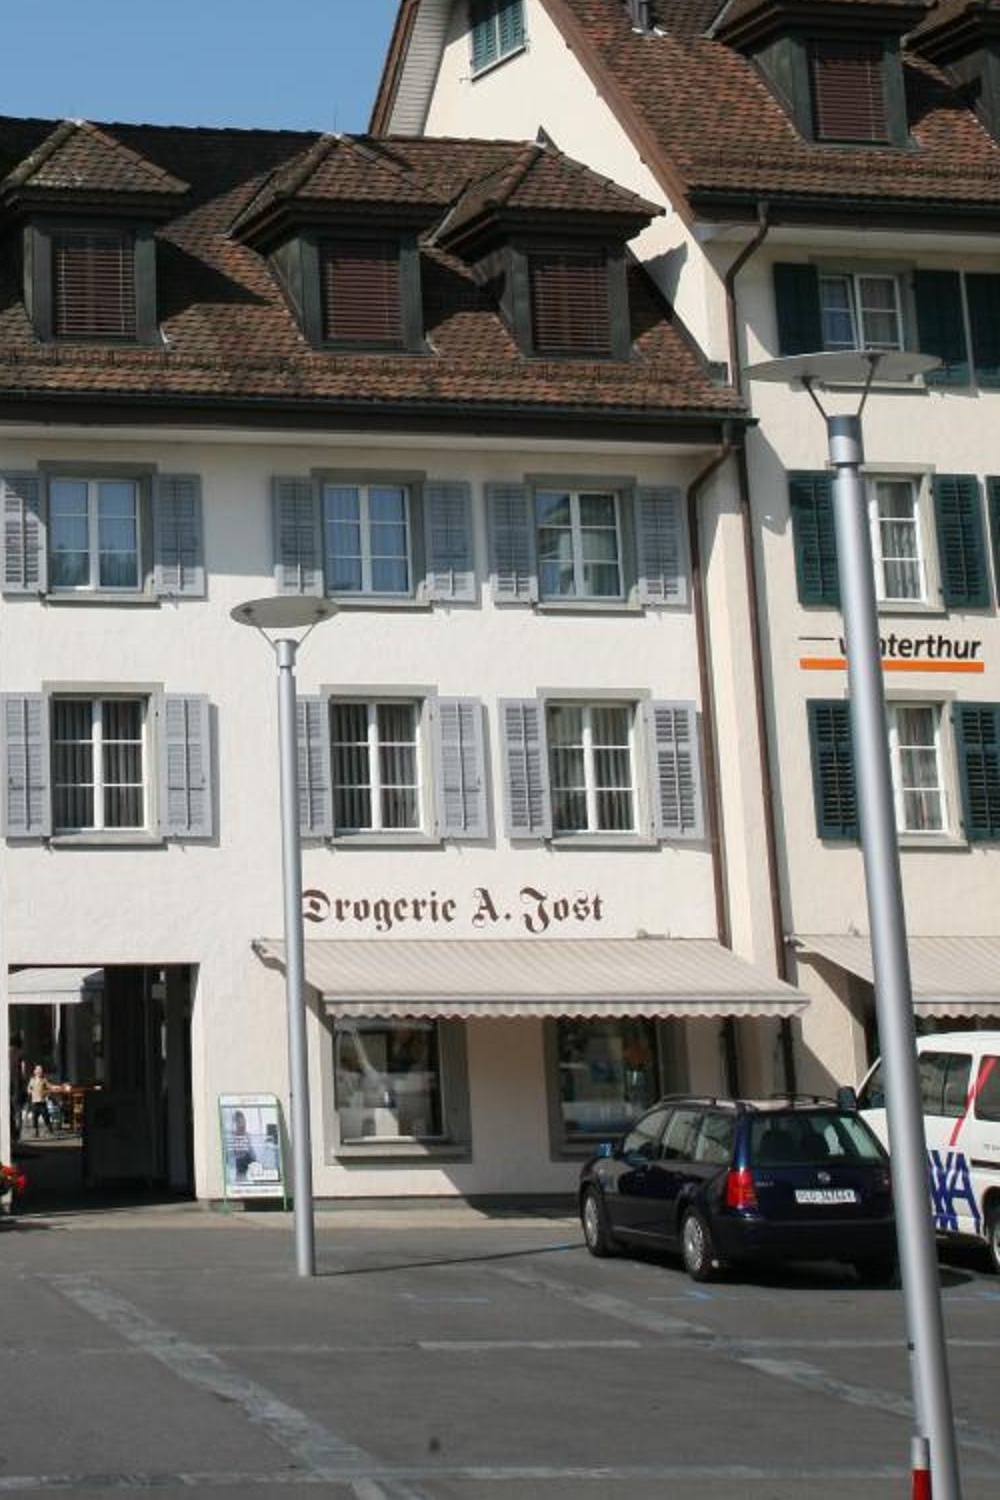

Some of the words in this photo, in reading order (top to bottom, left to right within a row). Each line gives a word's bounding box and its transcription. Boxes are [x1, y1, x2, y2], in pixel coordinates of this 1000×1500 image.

[302, 888, 457, 932] Drogerie
[472, 886, 512, 928] A.
[519, 886, 604, 933] Jost
